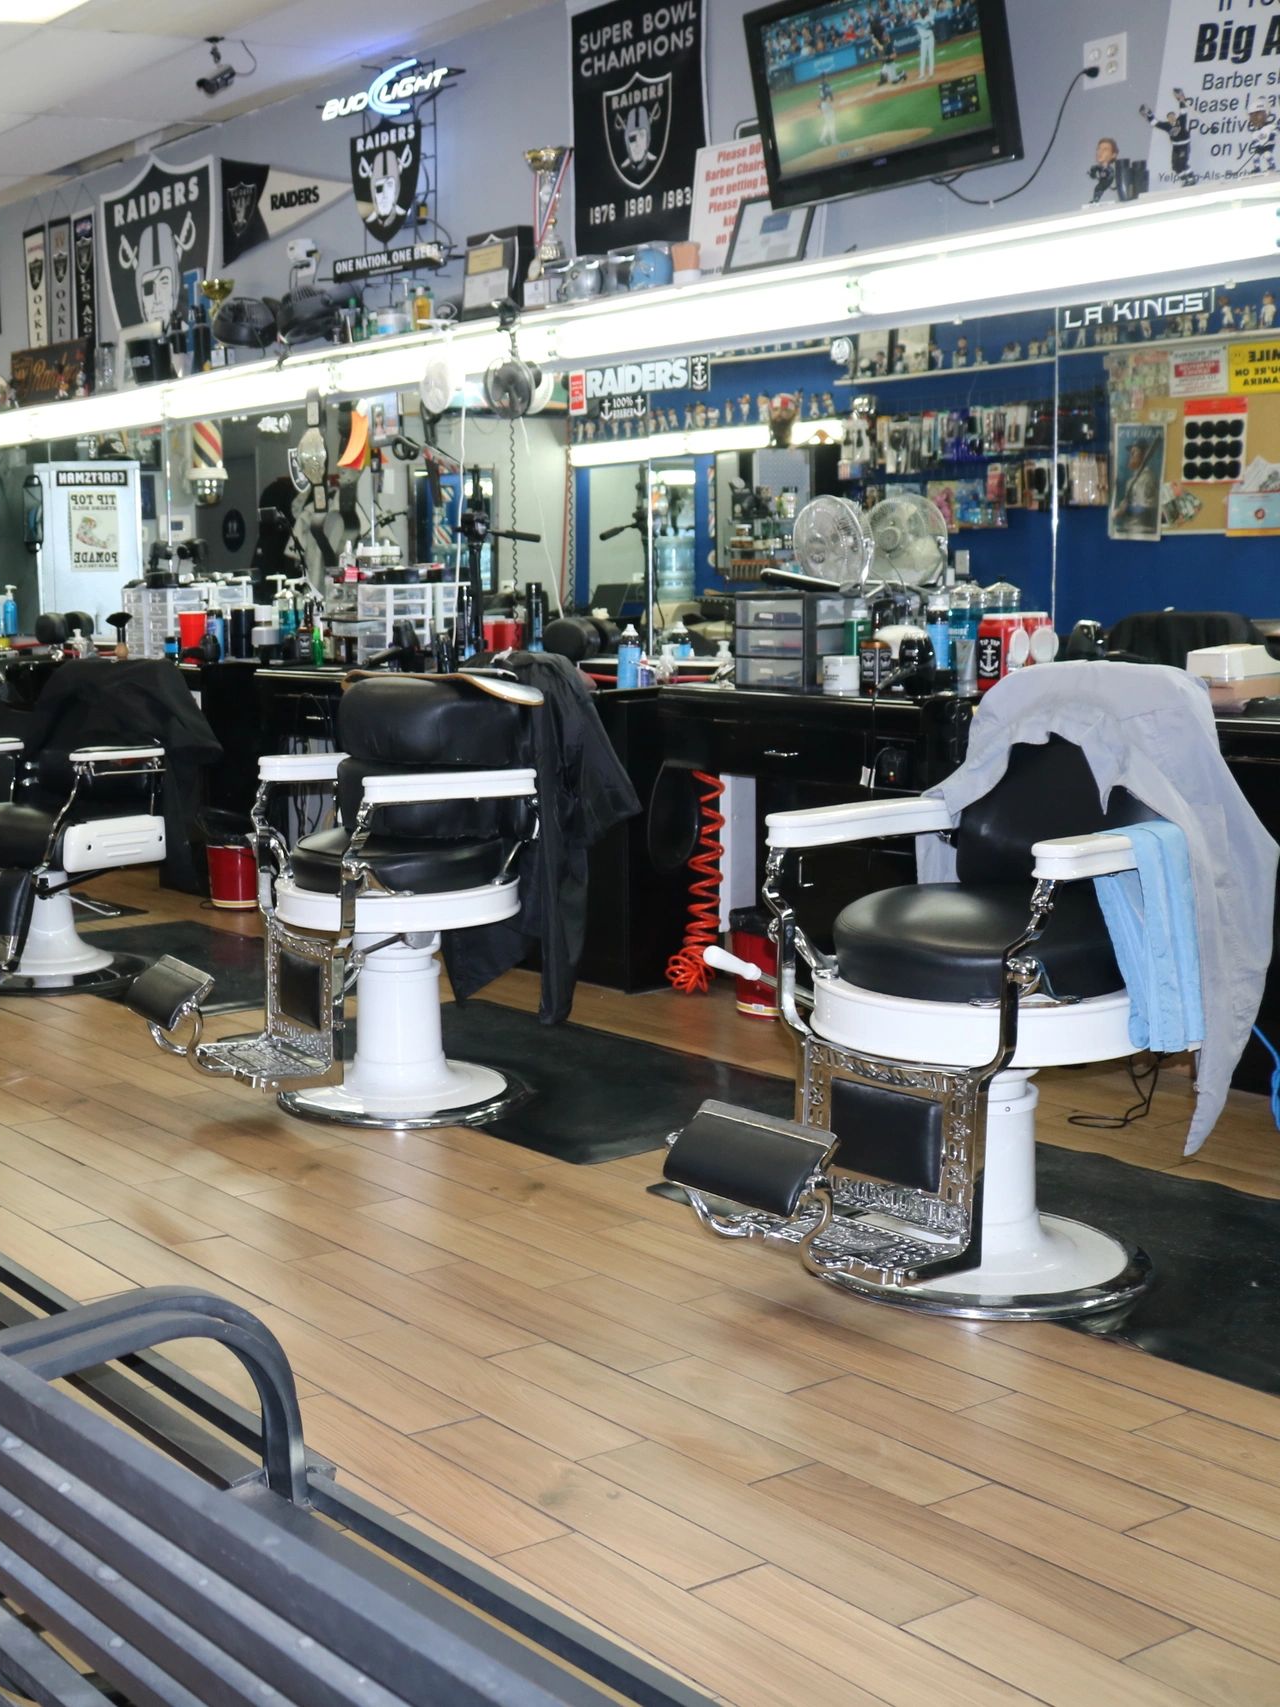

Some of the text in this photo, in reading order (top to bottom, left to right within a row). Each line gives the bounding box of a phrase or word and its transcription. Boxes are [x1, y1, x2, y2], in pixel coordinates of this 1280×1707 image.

[580, 0, 697, 55] SUPER BOWL
[580, 27, 694, 78] CHAMPIONS
[1194, 20, 1256, 64] Big
[321, 67, 448, 121] BUD LIGHT
[1202, 72, 1262, 90] Barber
[611, 82, 664, 110] RAIDERS
[356, 124, 415, 153] RAIDERS
[1189, 114, 1257, 135] Positive
[717, 145, 747, 163] Please
[1210, 143, 1232, 157] on
[705, 165, 736, 182] Barber
[709, 184, 725, 197] are
[726, 178, 759, 195] getting
[113, 175, 200, 228] RAIDERS
[270, 185, 320, 211] RAIDERS
[589, 186, 691, 226] 1976 1980 1983
[708, 197, 737, 214] Please
[335, 258, 354, 275] ONE
[355, 252, 391, 271] NATION.
[392, 248, 412, 264] ONE
[33, 295, 43, 344] OAKL
[56, 290, 66, 338] OAKL
[1064, 292, 1205, 329] LA KINGS
[586, 358, 688, 399] RAIDERS
[612, 396, 634, 410] 100%
